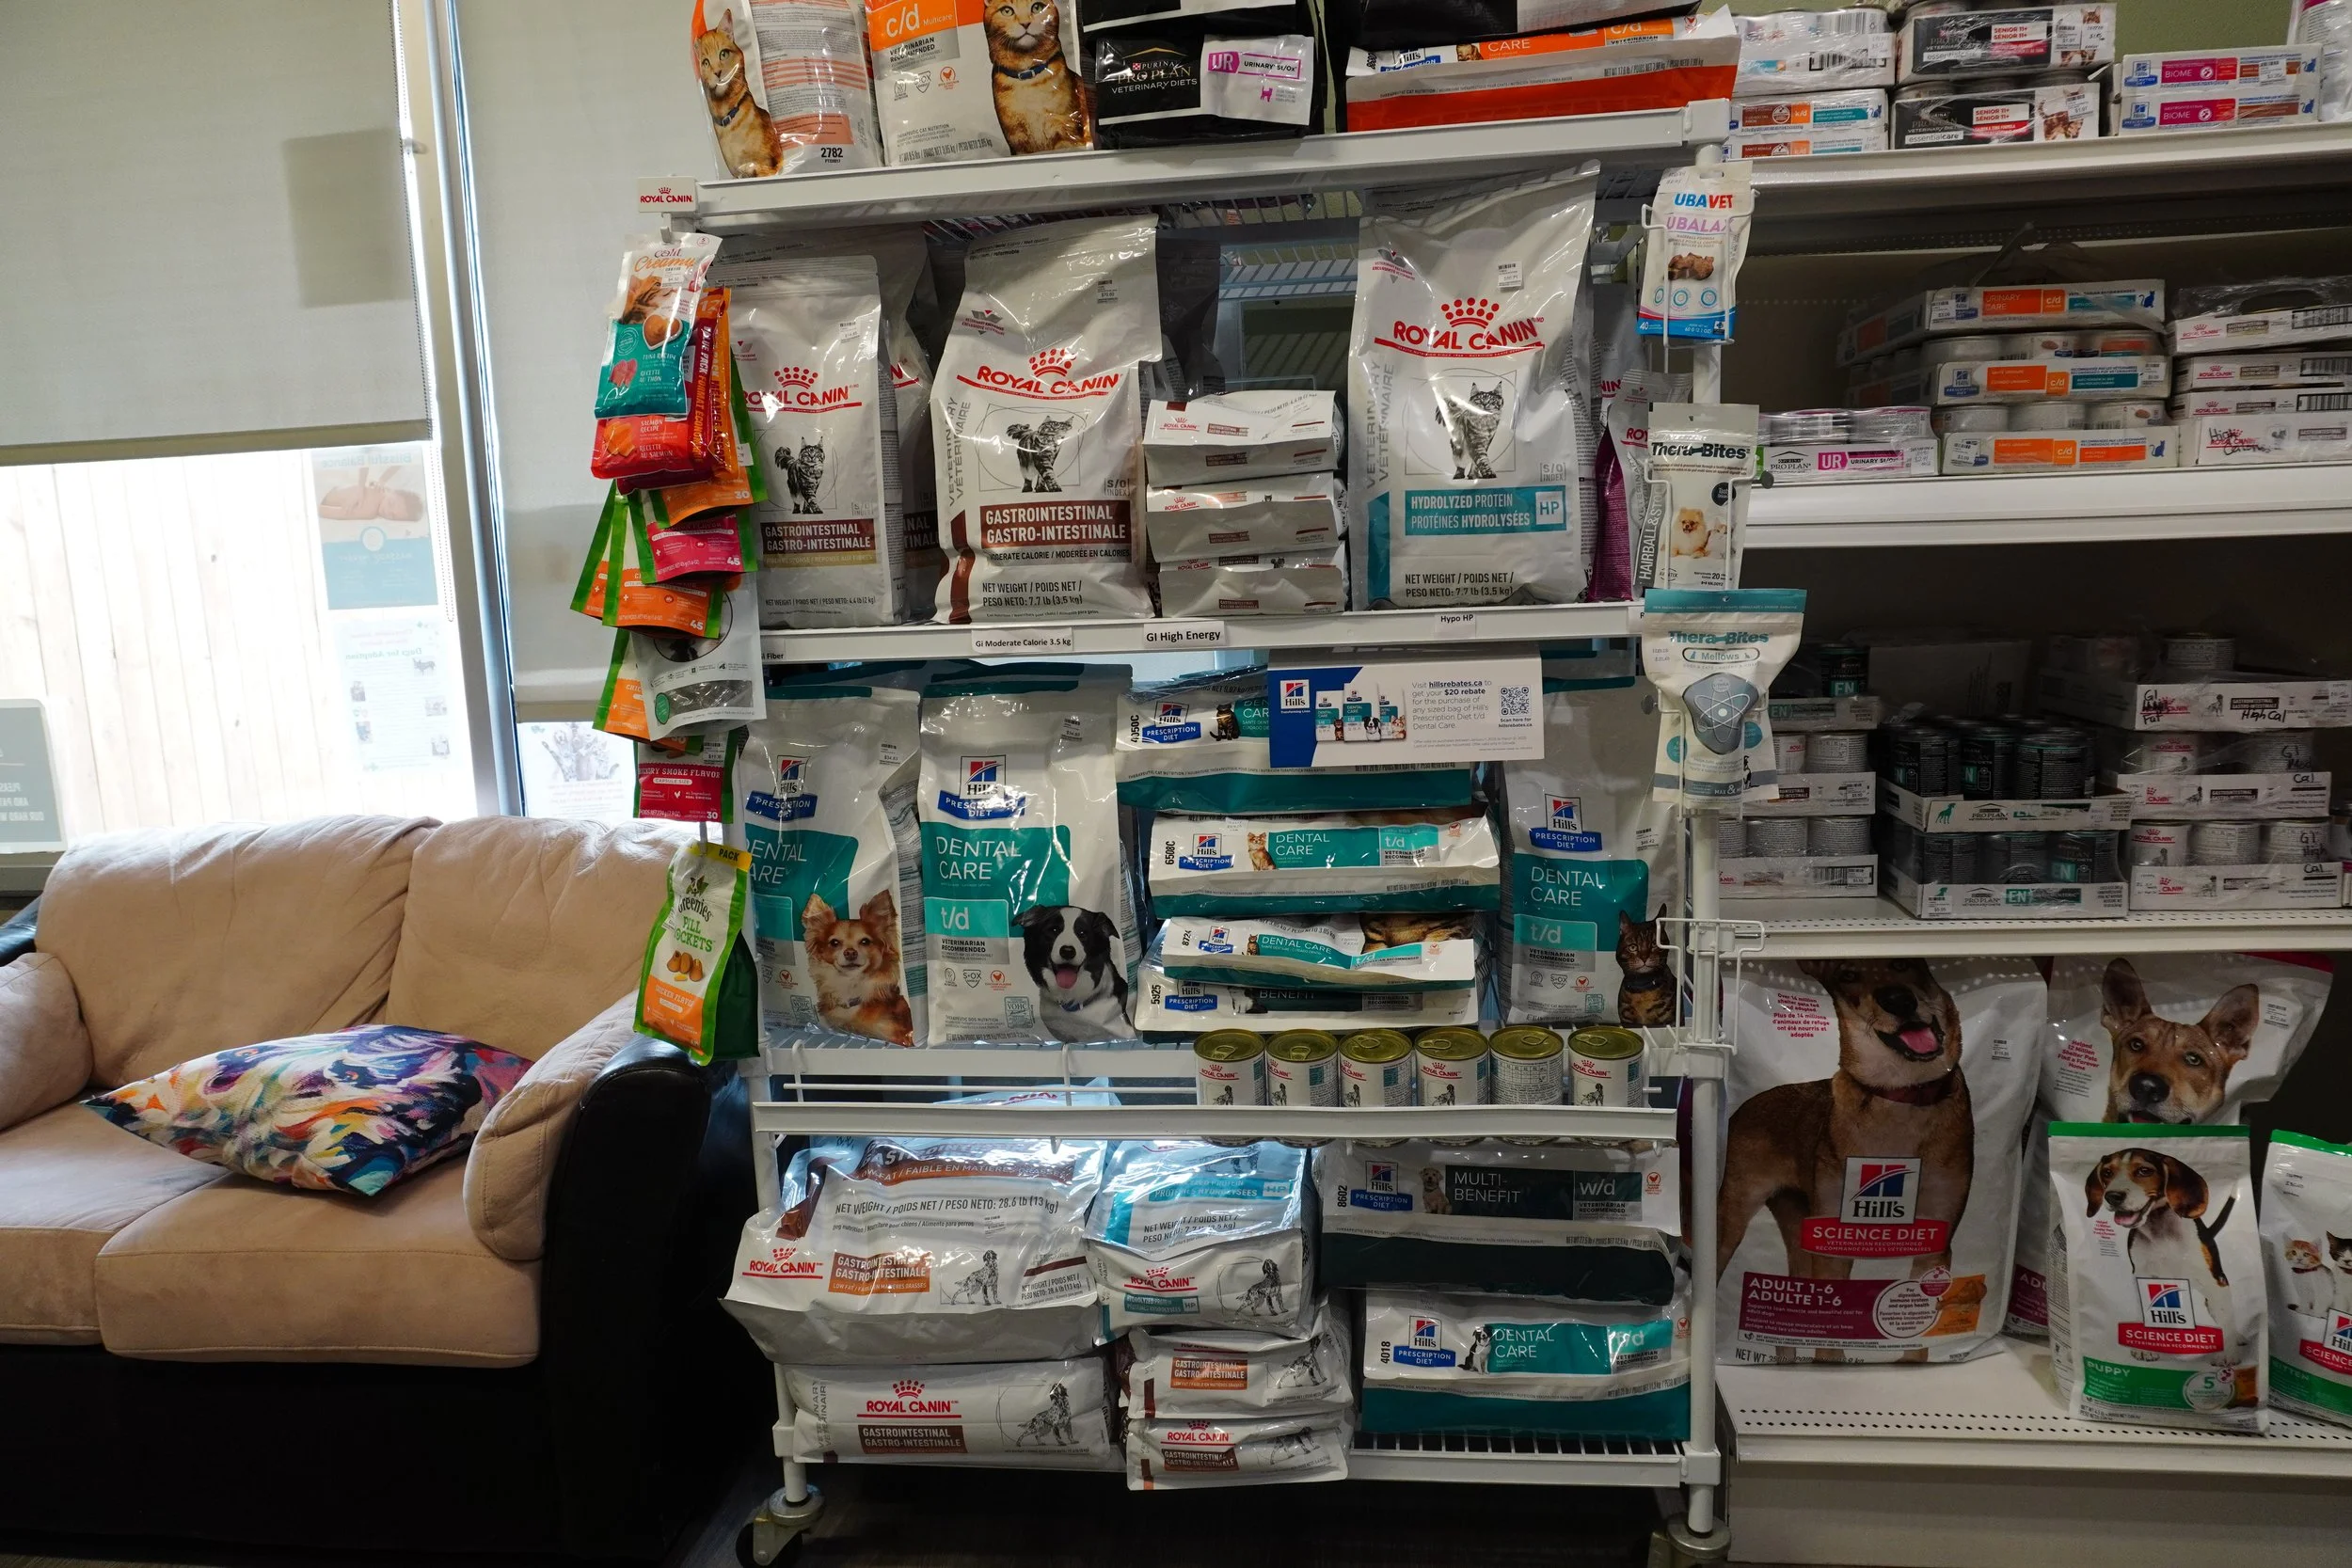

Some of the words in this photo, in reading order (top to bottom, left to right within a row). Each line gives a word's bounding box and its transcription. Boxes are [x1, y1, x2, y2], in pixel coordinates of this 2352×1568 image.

[886, 10, 920, 39] c/d
[923, 13, 953, 26] Multicare
[1487, 38, 1531, 53] CARE
[1211, 52, 1234, 71] UR
[2165, 69, 2192, 78] BIOME
[2163, 111, 2190, 120] BIOME
[1908, 132, 1960, 143] essentialcare
[820, 147, 844, 160] 2782
[640, 195, 663, 203] ROYAL
[665, 195, 693, 203] CANIN
[634, 255, 695, 273] Creamy
[1393, 320, 1462, 350] ROYAL
[1468, 318, 1538, 351] CANIN
[977, 365, 1044, 394] ROYAL
[1050, 373, 1120, 395] CANIN
[2049, 377, 2065, 388] c/d
[2057, 445, 2073, 456] c/d
[734, 489, 750, 499] 30
[1410, 495, 1472, 510] HYDROLYZED
[1474, 493, 1513, 508] PROTEIN
[985, 505, 1114, 525] GASTROINTESTINAL
[1538, 501, 1560, 516] HP
[1410, 514, 1459, 529] PROTÉINES
[1461, 512, 1531, 528] HYDROLYSÉES
[765, 522, 861, 538] GASTROINTESTINAL
[987, 524, 1126, 545] GASTRO-INTESTINALE
[767, 536, 871, 551] GASTRO-INTESTINALE
[726, 556, 740, 566] 45
[1405, 574, 1420, 585] NET
[1422, 573, 1455, 585] WEIGHT
[1463, 572, 1489, 584] POIDS
[1491, 572, 1507, 583] NET
[982, 582, 996, 594] NET
[997, 582, 1028, 594] WEIGHT
[1035, 581, 1059, 593] POIDS
[1061, 581, 1076, 592] NET
[690, 619, 704, 631] 45
[1440, 615, 1461, 624] Hypo
[1462, 613, 1474, 622] HP
[976, 640, 984, 648] Gi
[985, 638, 1022, 648] Moderate
[1023, 638, 1048, 647] Calorie
[1049, 638, 1061, 646] 3.5
[1061, 638, 1072, 648] kg
[1146, 631, 1158, 642] GI
[1159, 631, 1184, 644] High
[1185, 630, 1221, 644] Energy
[767, 652, 784, 660] Fiber
[1701, 651, 1740, 661] Mellows
[1428, 679, 1483, 689] hillsrebates.ca
[1835, 681, 1855, 695] EN
[1411, 689, 1423, 698] get
[1425, 689, 1443, 698] your
[1444, 688, 1459, 696] $20
[1461, 688, 1486, 696] rebate
[1285, 697, 1306, 706] Hill's
[1438, 696, 1471, 705] purchase
[1472, 695, 1481, 704] of
[1426, 705, 1446, 714] sized
[1447, 705, 1462, 714] bag
[1463, 704, 1471, 712] of
[1472, 704, 1489, 712] Hill's
[2241, 709, 2265, 721] High
[2268, 710, 2286, 722] Cal
[1412, 715, 1455, 723] Prescription
[1473, 712, 1486, 721] t/d
[1131, 714, 1139, 743] 4050C
[1146, 727, 1197, 736] PRESCRIPTION
[1412, 722, 1438, 731] Dental
[2293, 772, 2314, 784] Cal
[707, 809, 719, 820] 30
[968, 809, 993, 817] DIET
[1552, 819, 1578, 832] Hill's
[1275, 832, 1331, 845] DENTAL
[1384, 835, 1406, 849] t/d
[1534, 832, 1597, 845] PRESCRIPTION
[1556, 841, 1576, 849] DIET
[936, 835, 1022, 858] DENTAL
[1165, 840, 1176, 865] 6508C
[1275, 844, 1314, 857] CARE
[718, 848, 739, 863] PACK
[939, 861, 993, 880] CARE
[2304, 863, 2324, 874] Cal
[1531, 866, 1607, 888] DENTAL
[1531, 886, 1582, 907] CARE
[2008, 890, 2027, 904] EN
[682, 914, 703, 935] PILL
[940, 906, 970, 930] t/d
[1181, 928, 1193, 947] 8724
[1530, 924, 1562, 944] t/d
[941, 938, 986, 946] VETERINARIAN
[1261, 934, 1305, 949] DENTAL
[1306, 942, 1332, 956] CARE
[1371, 1180, 1393, 1192] Hill's
[1579, 1179, 1616, 1196] w/d
[1337, 1184, 1348, 1209] 8602
[1355, 1193, 1408, 1205] PRESCRIPTION
[1454, 1189, 1521, 1204] BENEFIT
[1372, 1200, 1391, 1210] DIET
[1851, 1200, 1905, 1219] Hill's
[1812, 1226, 1893, 1242] SCIENCE
[1896, 1227, 1939, 1241] DIET
[750, 1259, 778, 1274] ROYAL
[780, 1259, 818, 1274] CANIN
[1130, 1275, 1158, 1288] ROYAL
[1158, 1277, 1190, 1289] CANIN
[1749, 1276, 1805, 1292] ADULT
[1809, 1283, 1835, 1295] 1-6
[1747, 1290, 1814, 1306] ADULTE
[1818, 1295, 1843, 1307] 1-6
[2150, 1309, 2187, 1325] Hill's
[1494, 1328, 1555, 1343] DENTAL
[2125, 1328, 2184, 1344] SCIENCE
[2185, 1332, 2217, 1344] DIET
[1414, 1337, 1438, 1348] Hill's
[1381, 1340, 1391, 1365] 4018
[1398, 1349, 1452, 1361] PRESCRIPTION
[1494, 1345, 1537, 1359] CARE
[1735, 1347, 1753, 1361] NET
[1754, 1352, 1768, 1363] WT
[1415, 1356, 1434, 1366] DIET
[1173, 1369, 1245, 1380] GASTRO-INTESTINALE
[866, 1399, 906, 1414] ROYAL
[909, 1399, 951, 1414] CANIN
[862, 1427, 951, 1439] GASTROINTESTINAL
[1167, 1431, 1197, 1442] ROYAL
[1198, 1432, 1230, 1442] CANIN
[864, 1437, 961, 1449] GASTRO-INTESTINALE
